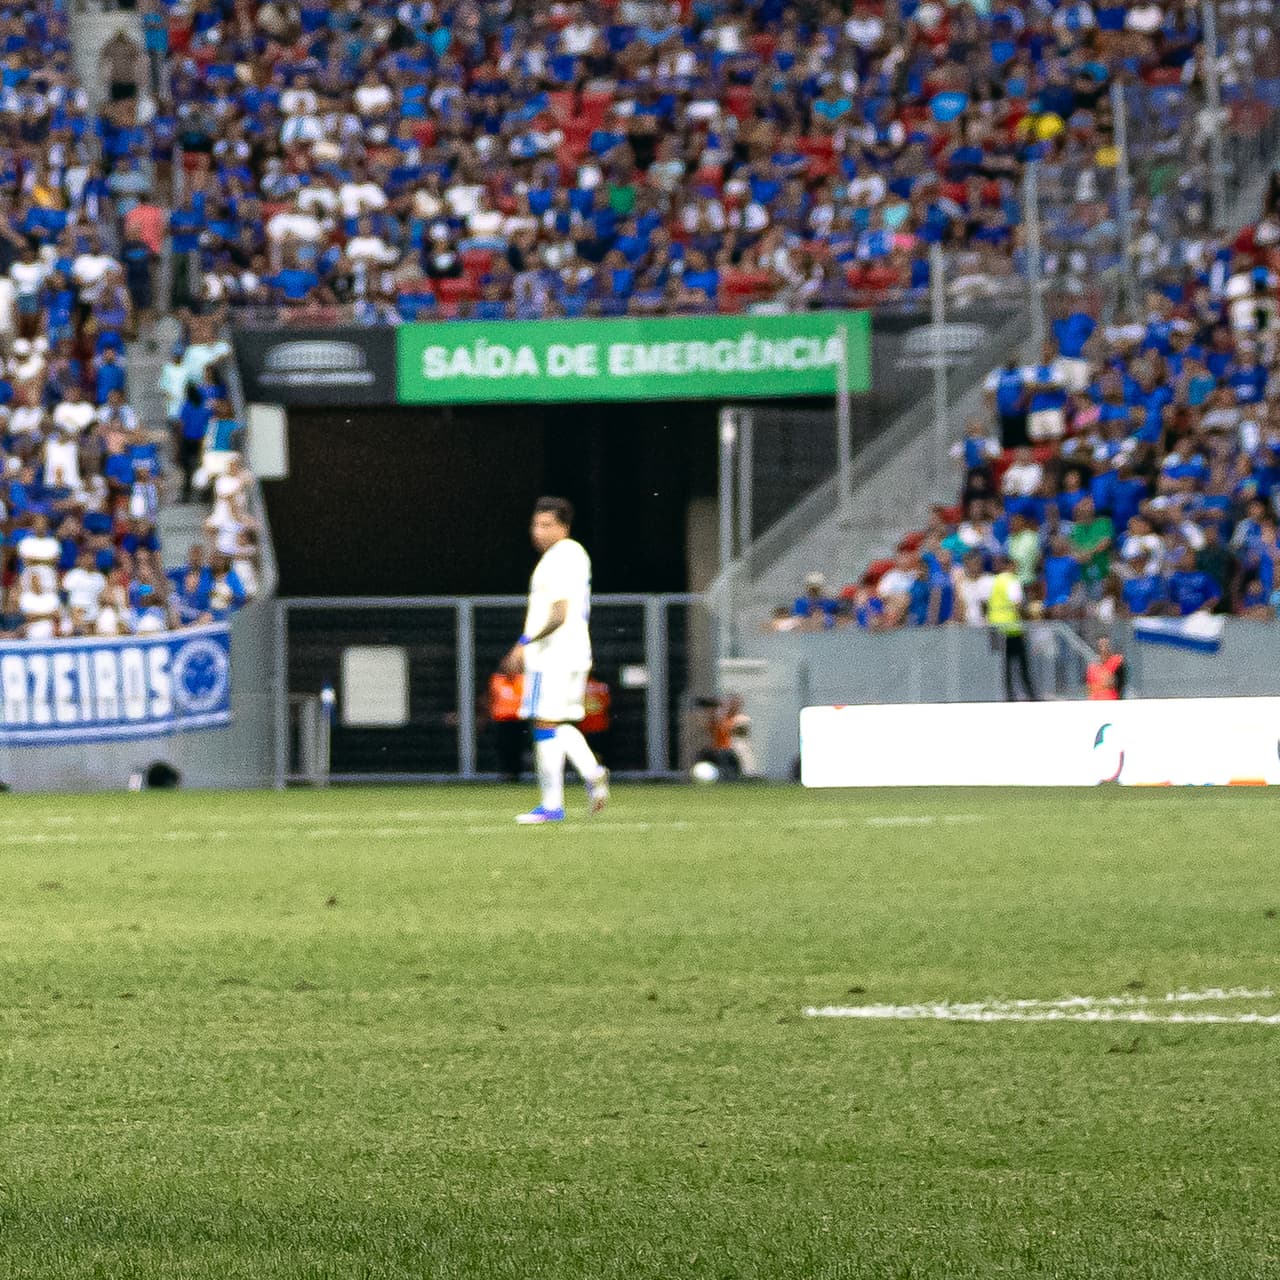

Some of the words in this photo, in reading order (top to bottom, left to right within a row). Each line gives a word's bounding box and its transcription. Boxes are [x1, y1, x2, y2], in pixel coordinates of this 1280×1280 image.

[423, 337, 539, 380] SAÍDA
[547, 343, 598, 377] DE
[608, 331, 844, 376] EMERGÊNCIA
